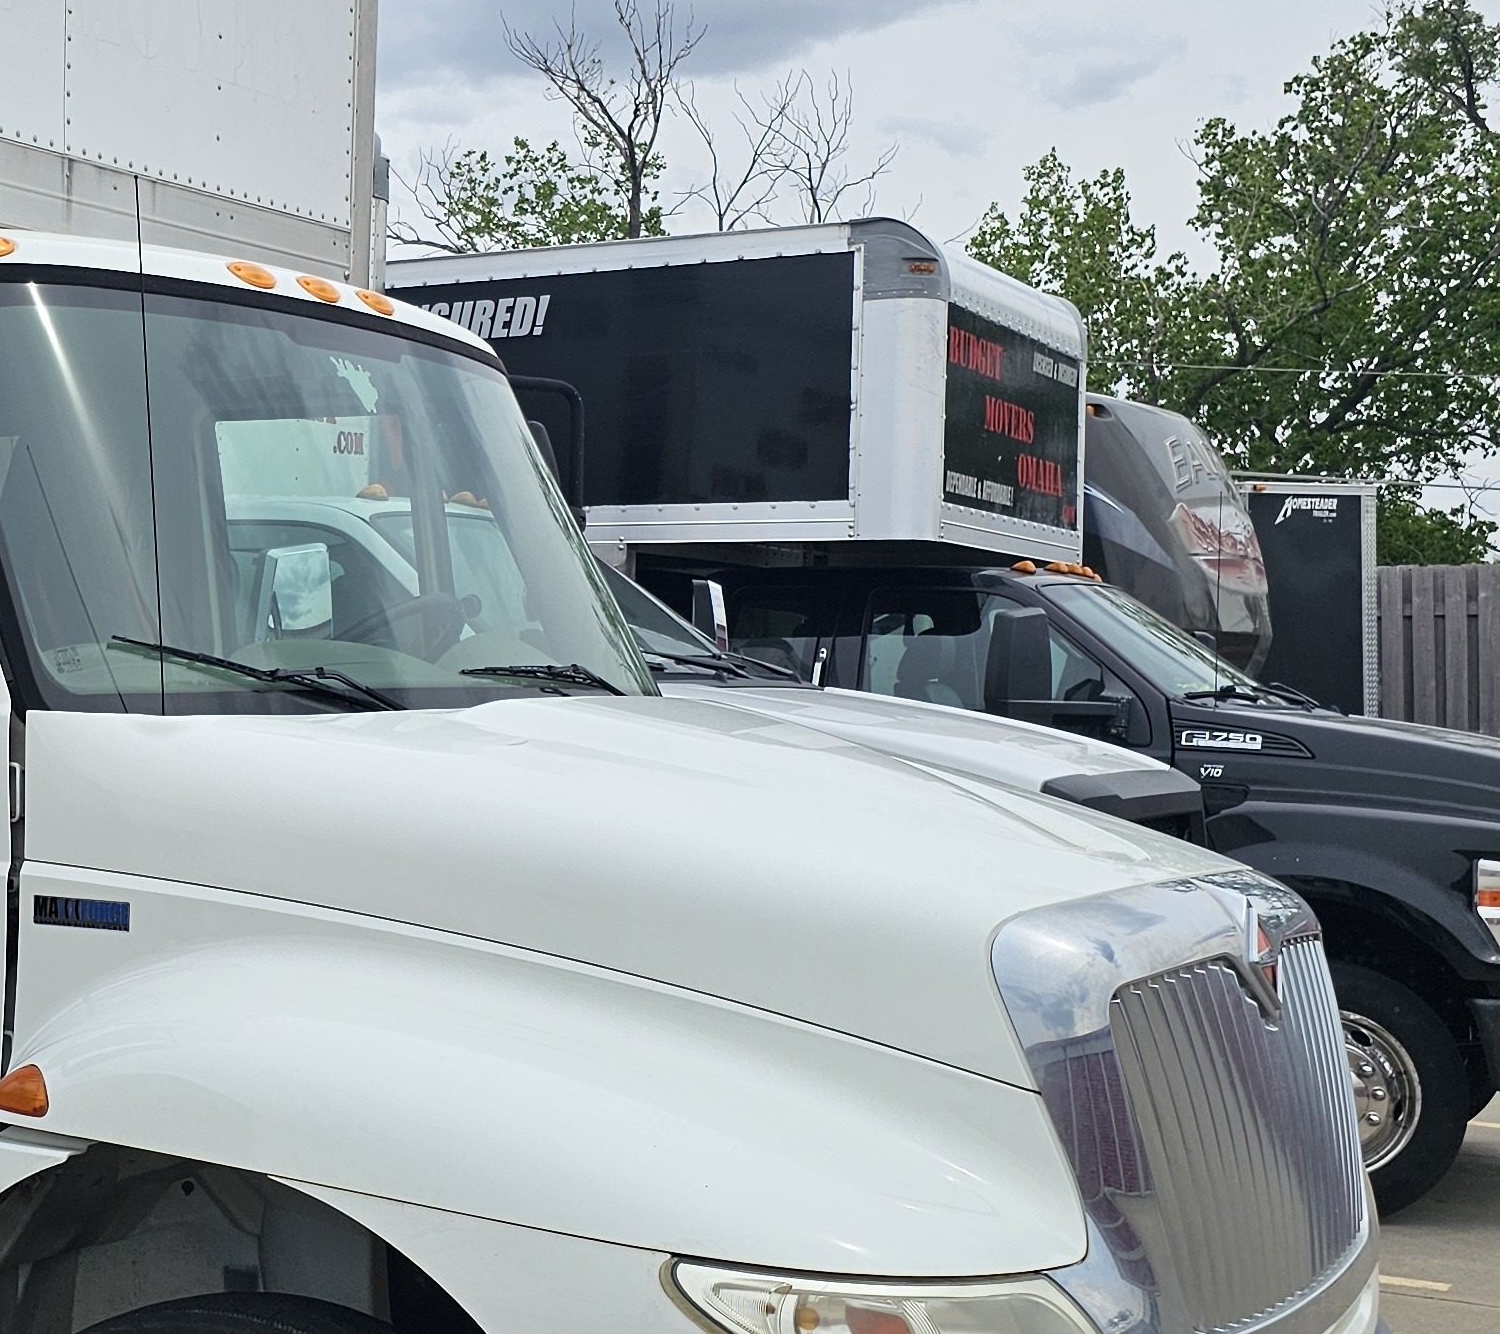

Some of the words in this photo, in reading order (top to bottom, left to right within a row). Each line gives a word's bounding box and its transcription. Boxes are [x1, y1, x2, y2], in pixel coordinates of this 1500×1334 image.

[949, 325, 1004, 381] BUDGET
[984, 394, 1035, 444] MOVERS
[333, 431, 365, 455] .COM
[1018, 452, 1063, 498] OMAHA
[1275, 495, 1338, 525] HOMESTEADER
[1200, 767, 1223, 779] V10
